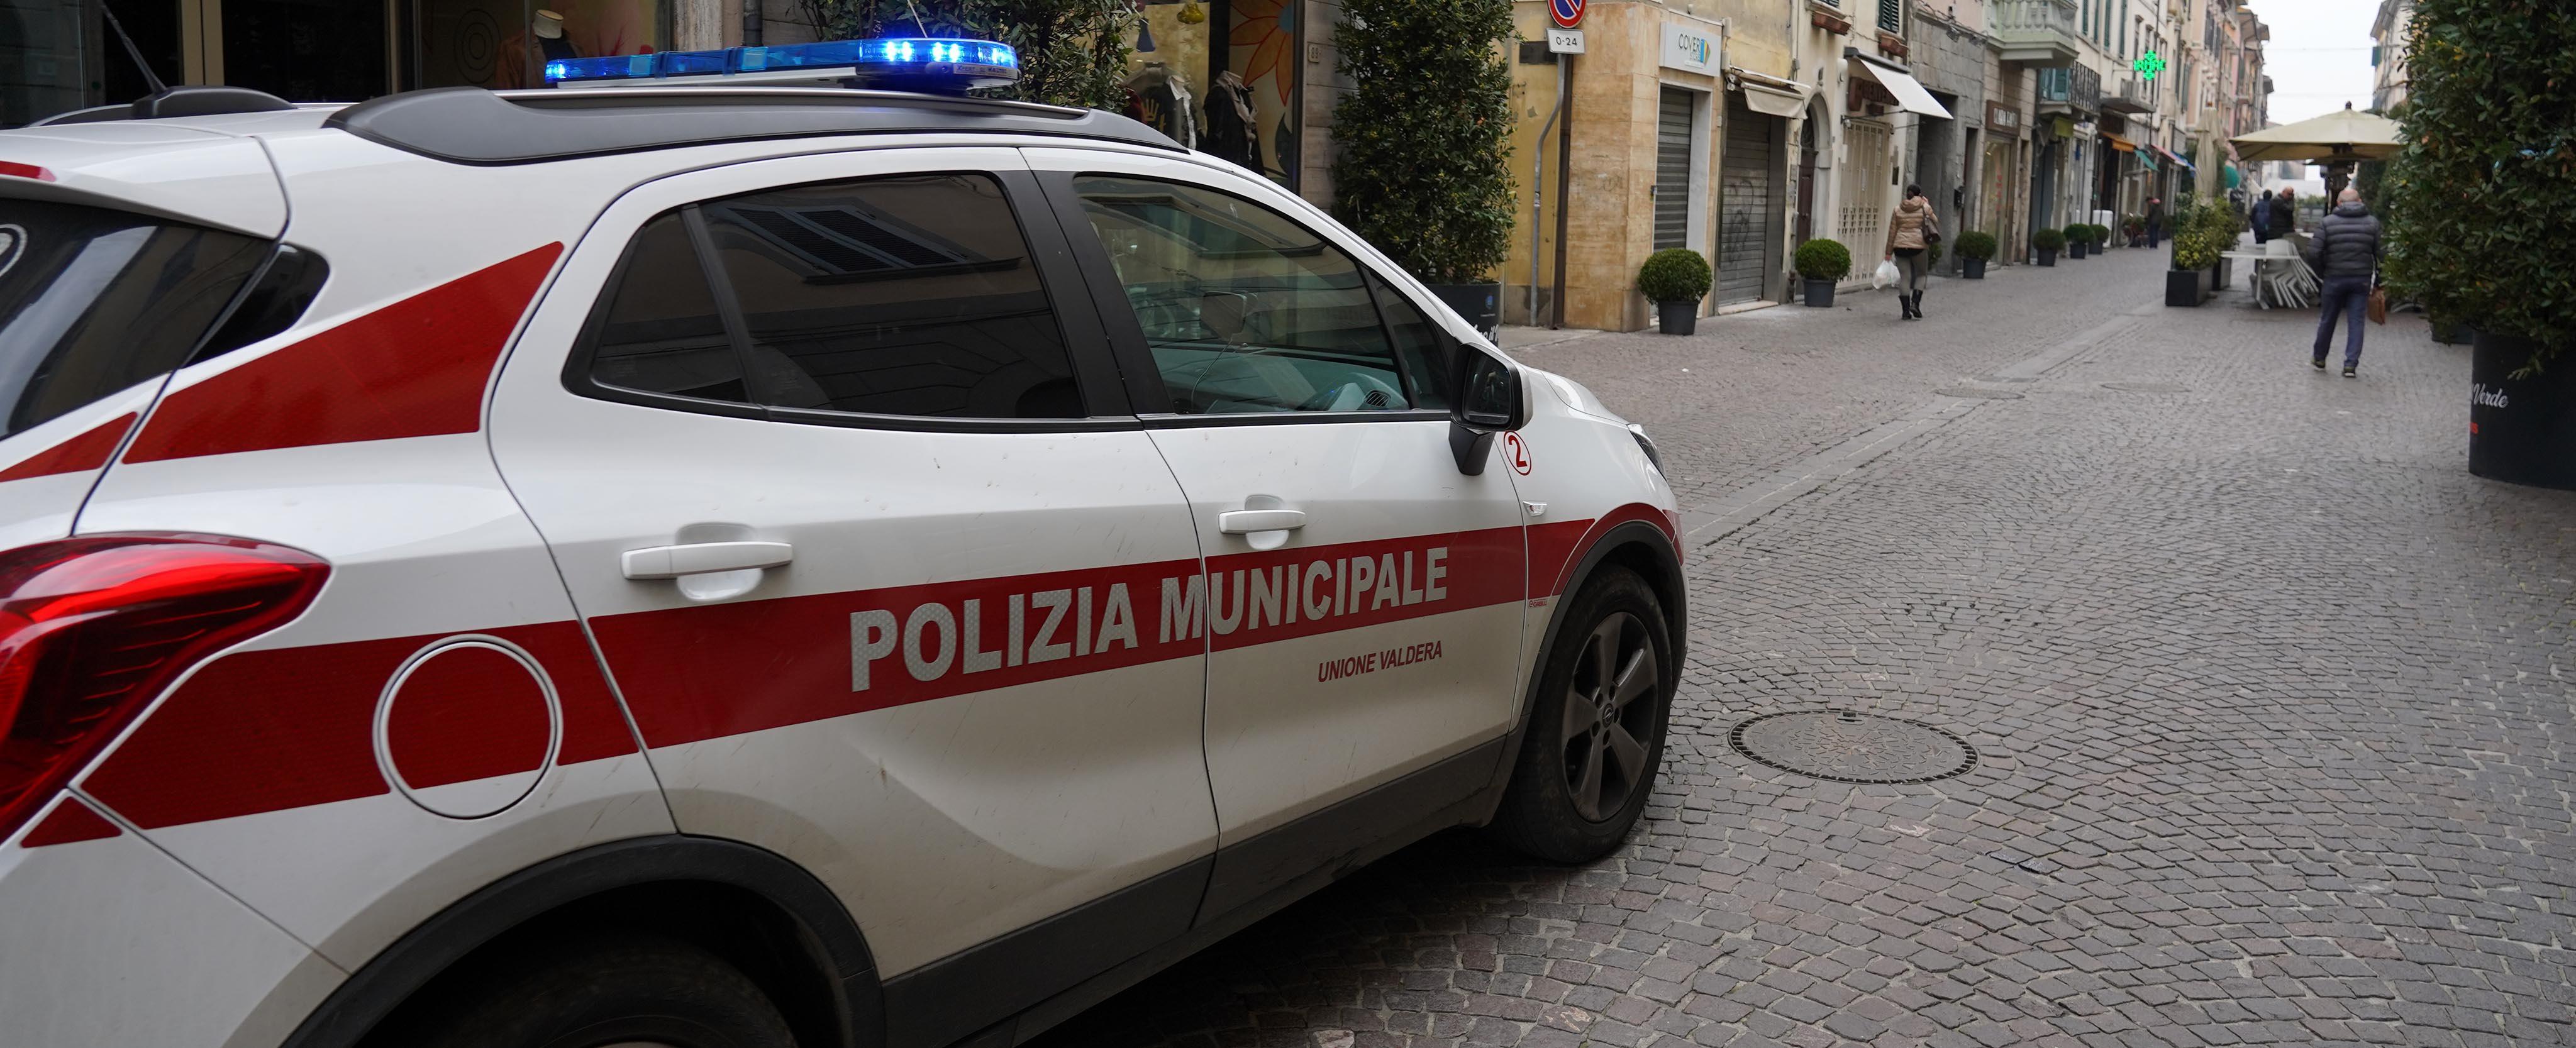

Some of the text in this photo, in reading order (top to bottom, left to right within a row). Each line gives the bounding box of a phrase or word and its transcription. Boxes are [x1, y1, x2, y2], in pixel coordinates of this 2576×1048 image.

[1555, 36, 1577, 46] 0-24
[1678, 33, 1701, 55] COVER
[2473, 383, 2508, 409] Verde
[1508, 435, 1528, 468] 2
[850, 546, 1448, 692] POLIZIA MUNICIPALE
[1318, 640, 1442, 683] UNIONE VALDERA
